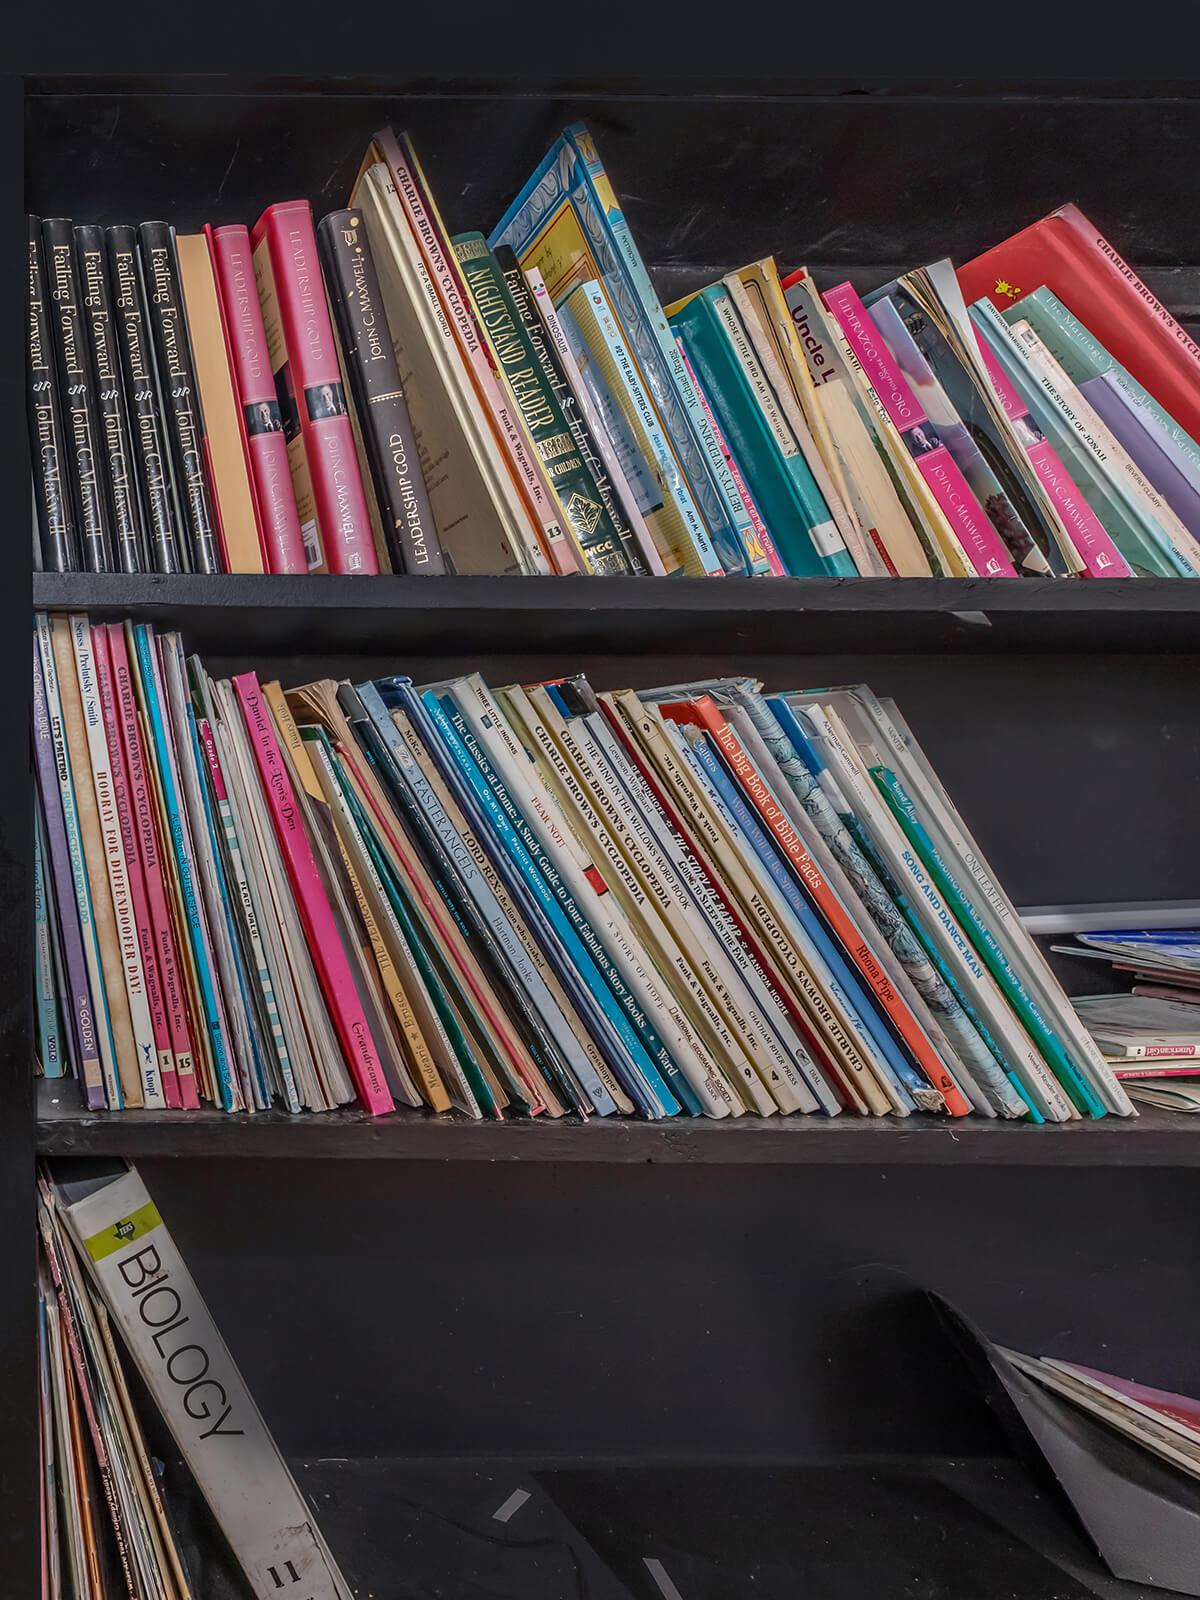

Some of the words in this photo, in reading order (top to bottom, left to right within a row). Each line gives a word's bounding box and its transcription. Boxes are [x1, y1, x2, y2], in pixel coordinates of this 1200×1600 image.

[393, 165, 425, 219] CHARLIE
[415, 217, 448, 273] BROWN'S
[51, 243, 74, 302] Failing
[82, 248, 105, 307] Failing
[115, 250, 138, 308] Failing
[149, 245, 173, 304] Failing
[351, 252, 372, 312] MAXWELL
[286, 230, 316, 317] LEADERSHIP
[303, 318, 324, 362] GOLD
[58, 303, 84, 374] Forward
[159, 304, 187, 377] Forward
[362, 311, 376, 326] C.
[792, 304, 826, 363] Uncle
[89, 308, 116, 380] Forward
[122, 309, 150, 380] Forward
[365, 325, 386, 361] JOHN
[468, 267, 525, 366] NIGHTSTAND
[511, 367, 555, 430] READER
[69, 404, 91, 444] John
[102, 409, 124, 449] John
[136, 410, 159, 450] John
[174, 407, 197, 448] John
[1039, 375, 1057, 396] THE
[1052, 393, 1077, 422] STORY
[1072, 419, 1086, 434] OF
[1081, 432, 1107, 462] JONAH
[75, 446, 94, 466] C.
[108, 451, 126, 471] C.
[143, 451, 162, 471] C.
[181, 448, 201, 469] C.
[388, 431, 409, 475] GOLD
[77, 467, 103, 537] Maxwell
[111, 472, 136, 541] Maxwell
[146, 472, 172, 542] Maxwell
[185, 469, 213, 540] Maxwell
[323, 434, 343, 470] JOHN
[333, 483, 357, 543] MAXWELL
[397, 475, 429, 564] LEADERSHIP
[50, 715, 62, 740] LET'S
[116, 666, 134, 721] CHARLIE
[125, 722, 144, 781] BROWN'S
[244, 690, 269, 733] Daniel
[449, 711, 470, 736] The
[53, 739, 69, 781] PRETEND
[260, 734, 272, 748] in
[264, 748, 278, 767] the
[403, 728, 424, 758] McKee
[461, 731, 493, 775] Classics
[94, 770, 114, 823] HOORAY
[266, 766, 291, 803] Lion's
[485, 772, 498, 786] at
[279, 801, 300, 832] Den
[492, 783, 520, 820] Home:
[513, 818, 525, 829] A
[714, 722, 740, 753] The
[730, 749, 753, 775] Big
[745, 772, 774, 807] Book
[764, 803, 782, 821] of
[773, 818, 803, 855] Bible
[794, 851, 824, 890] Facts
[104, 827, 119, 855] FOR
[411, 777, 448, 829] EASTER
[439, 825, 478, 881] ANGELS
[517, 826, 543, 858] Study
[536, 854, 562, 887] Guide
[108, 858, 138, 959] DIFFENDOOFER
[460, 829, 486, 866] LORD
[480, 864, 503, 895] REX:
[496, 892, 510, 908] the
[504, 906, 519, 924] lion
[513, 922, 530, 942] who
[524, 940, 545, 969] wished
[555, 886, 568, 900] to
[563, 898, 584, 926] Four
[899, 849, 925, 884] SONG
[919, 881, 942, 911] AND
[936, 908, 966, 951] DANCE
[960, 949, 984, 979] MAN
[578, 923, 611, 970] Fabulous
[126, 964, 142, 995] DAY!
[604, 967, 629, 999] Story
[853, 943, 883, 980] Rhona
[872, 976, 897, 1004] Pipe
[76, 1008, 96, 1052] GOLDEN
[623, 996, 647, 1029] Books
[350, 1020, 384, 1095] Grandreams
[654, 1046, 680, 1077] Ward
[142, 1068, 159, 1098] Knopf
[117, 1244, 245, 1440] BIOLOGY
[267, 1560, 302, 1588] 11
